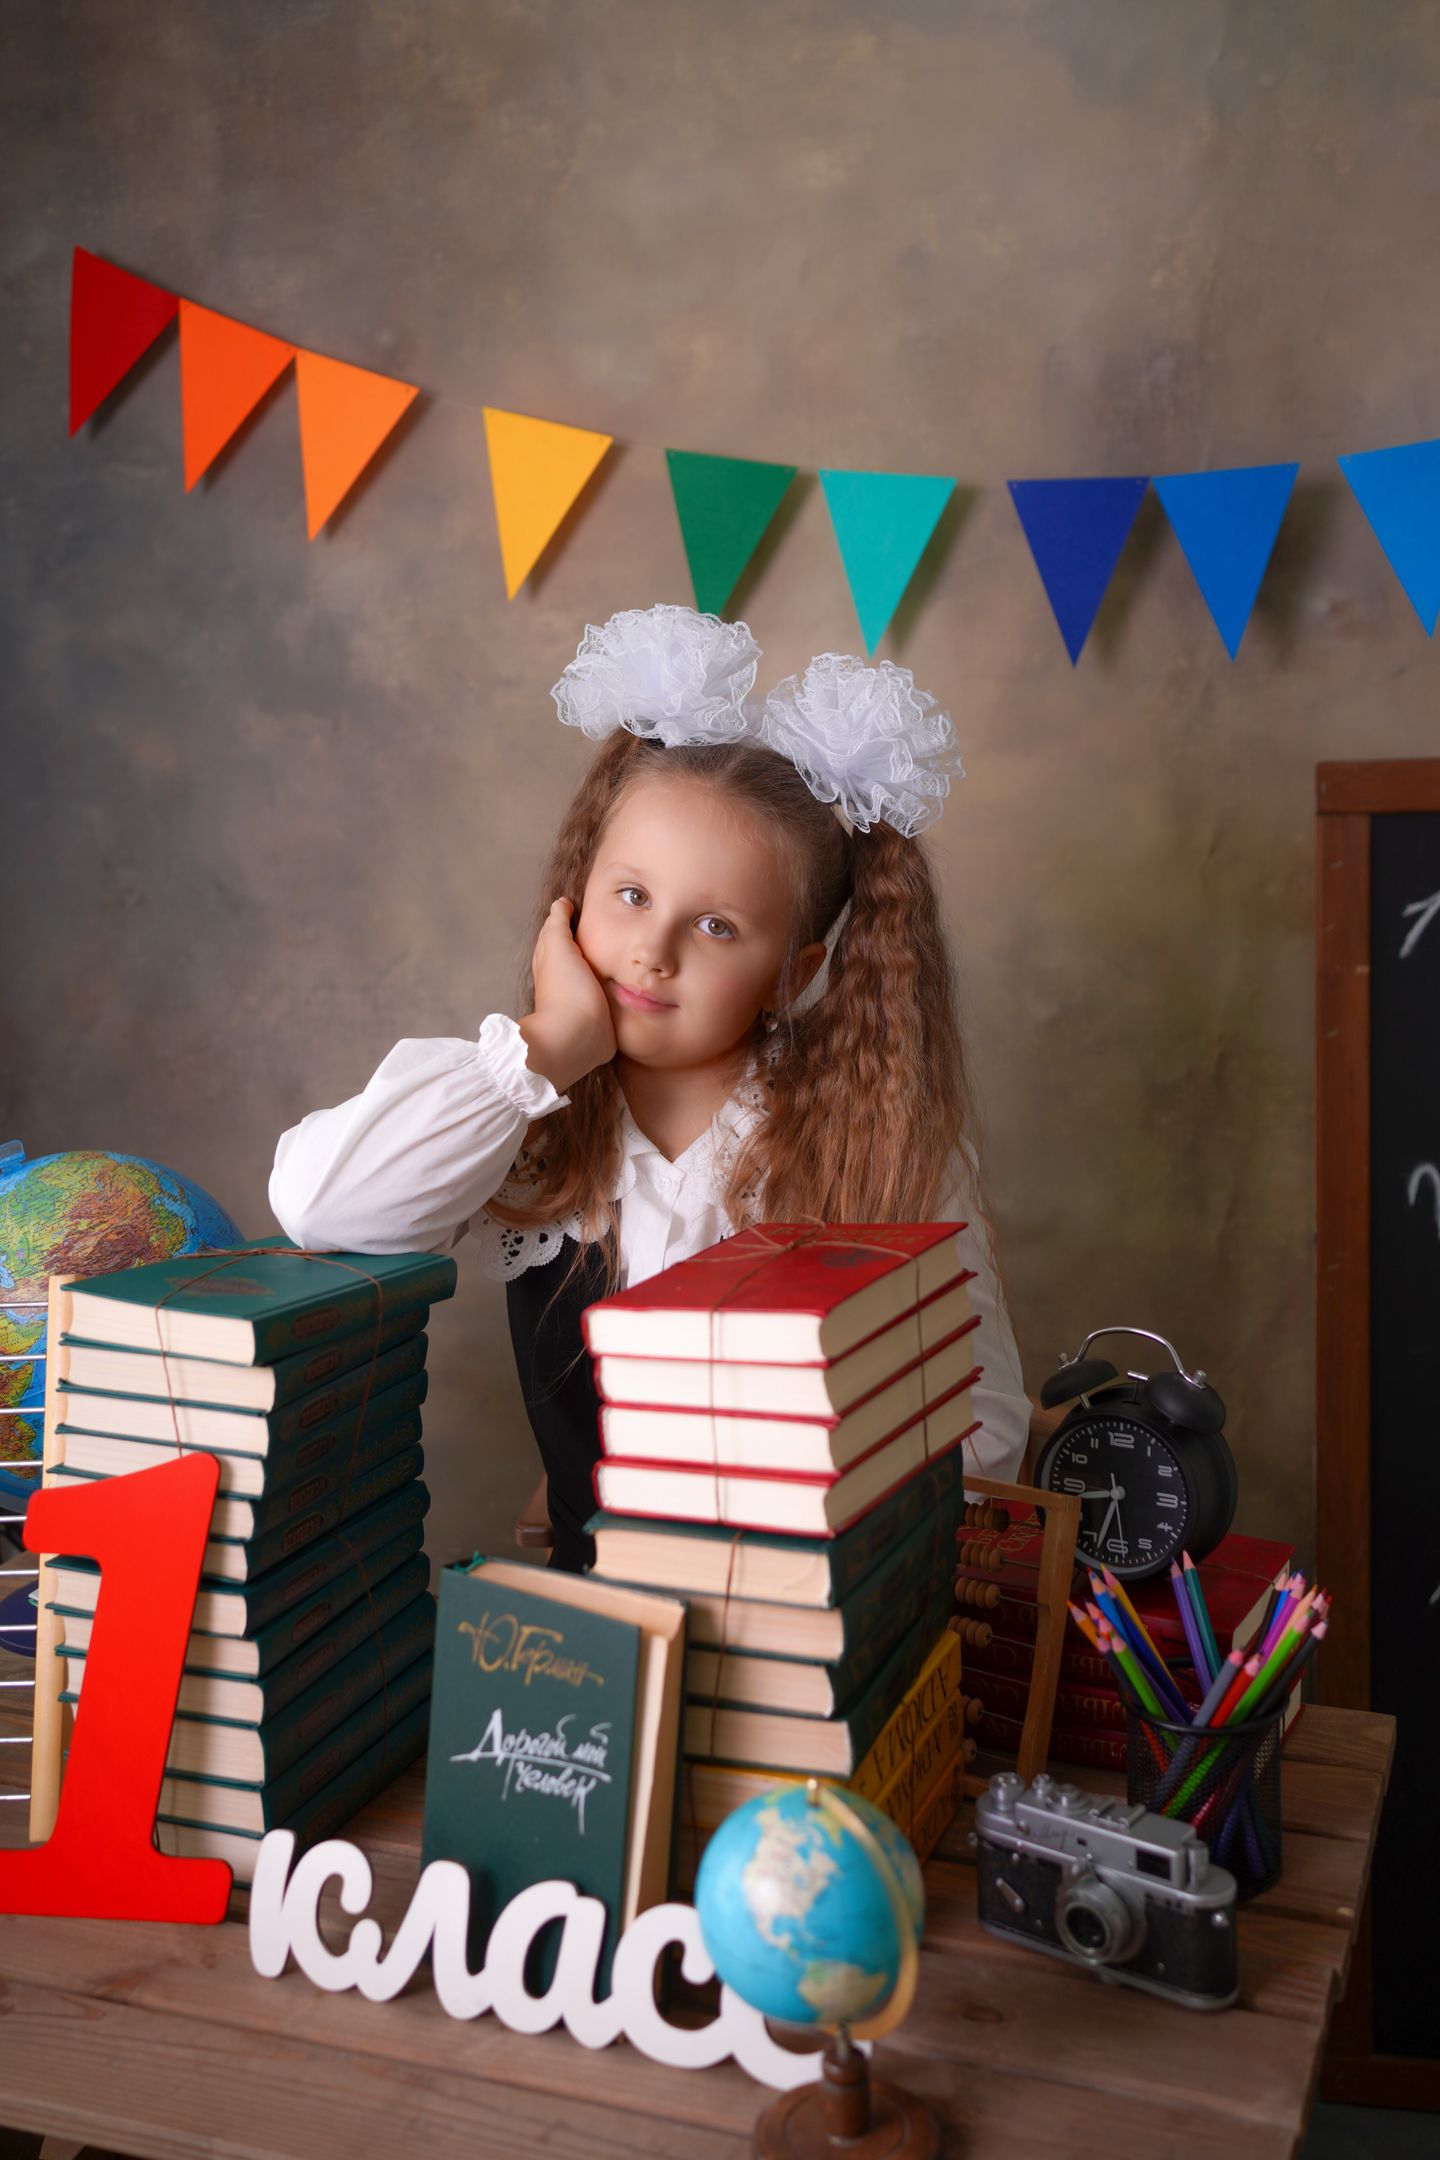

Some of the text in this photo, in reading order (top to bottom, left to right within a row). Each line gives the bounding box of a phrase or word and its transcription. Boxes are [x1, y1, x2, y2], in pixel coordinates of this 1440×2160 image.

[1090, 1437, 1099, 1449] 11
[1108, 1431, 1135, 1449] 12
[1071, 1452, 1088, 1465] 10
[1157, 1464, 1174, 1478] 2
[1063, 1477, 1087, 1494] 9
[1156, 1491, 1179, 1509] 3
[1156, 1521, 1173, 1533] 4
[1082, 1530, 1098, 1543] 7
[1106, 1538, 1129, 1555] 6
[1137, 1538, 1153, 1551] 5
[0, 1452, 233, 1925] 1
